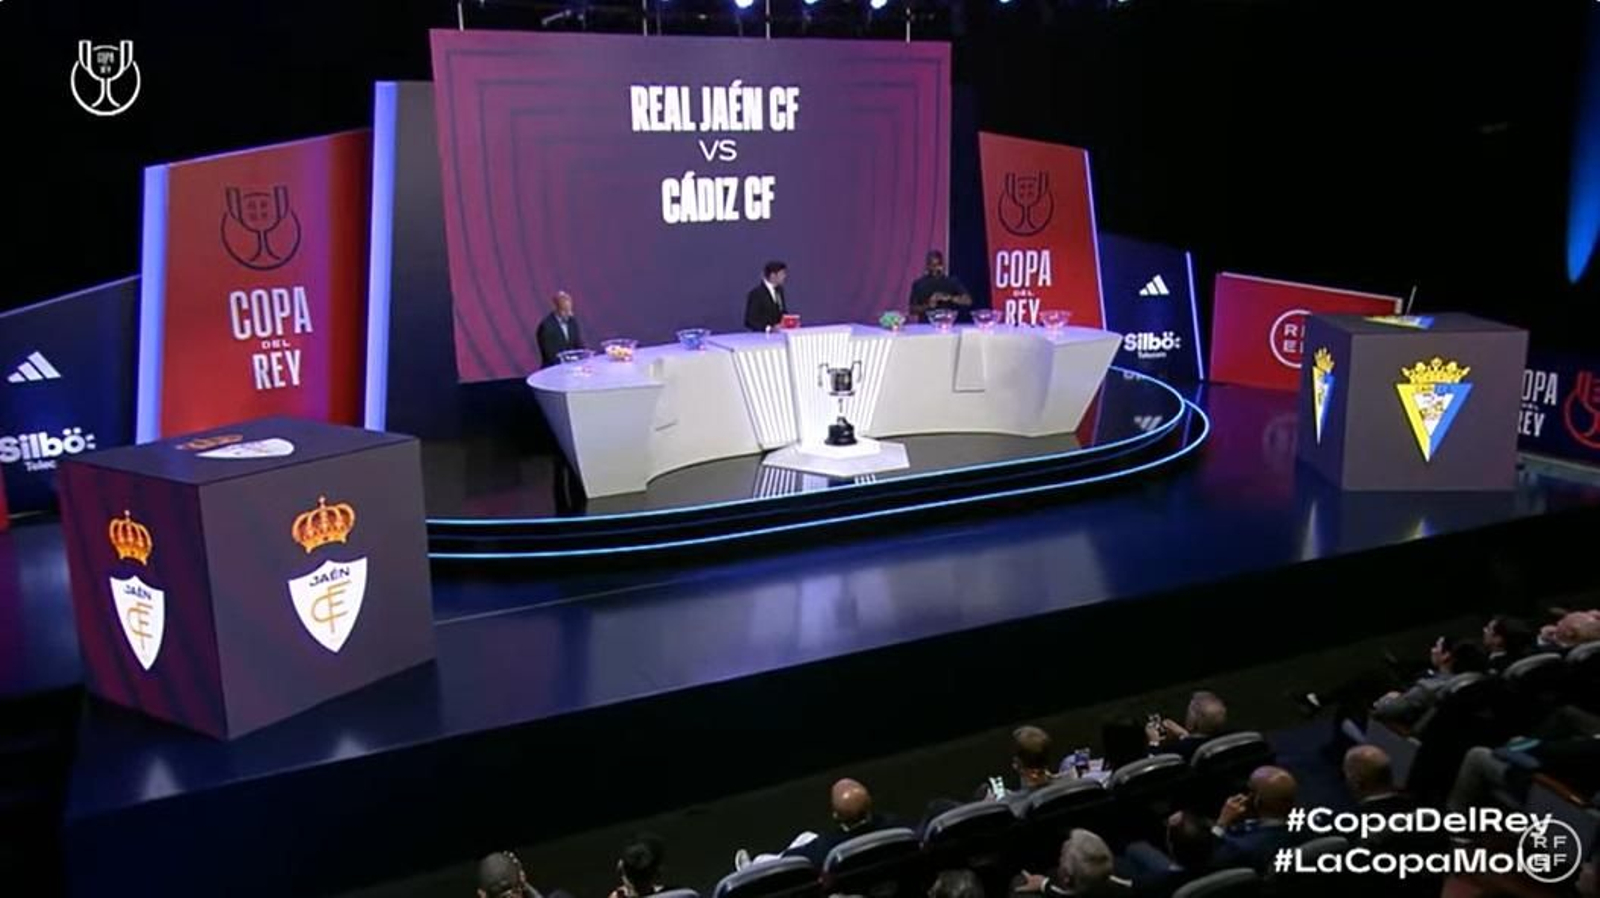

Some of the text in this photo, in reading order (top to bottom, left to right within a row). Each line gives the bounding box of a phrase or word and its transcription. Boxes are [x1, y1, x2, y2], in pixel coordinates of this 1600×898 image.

[630, 79, 800, 132] REAL JAÉN CF
[699, 139, 738, 162] VS
[661, 171, 776, 224] CÁDIZ CF
[995, 249, 1052, 289] COPA
[230, 286, 314, 340] COPA
[1004, 298, 1041, 326] REY
[261, 339, 291, 350] DEL
[252, 350, 302, 391] REY
[1521, 368, 1559, 406] OPA
[309, 566, 350, 588] JAÉN
